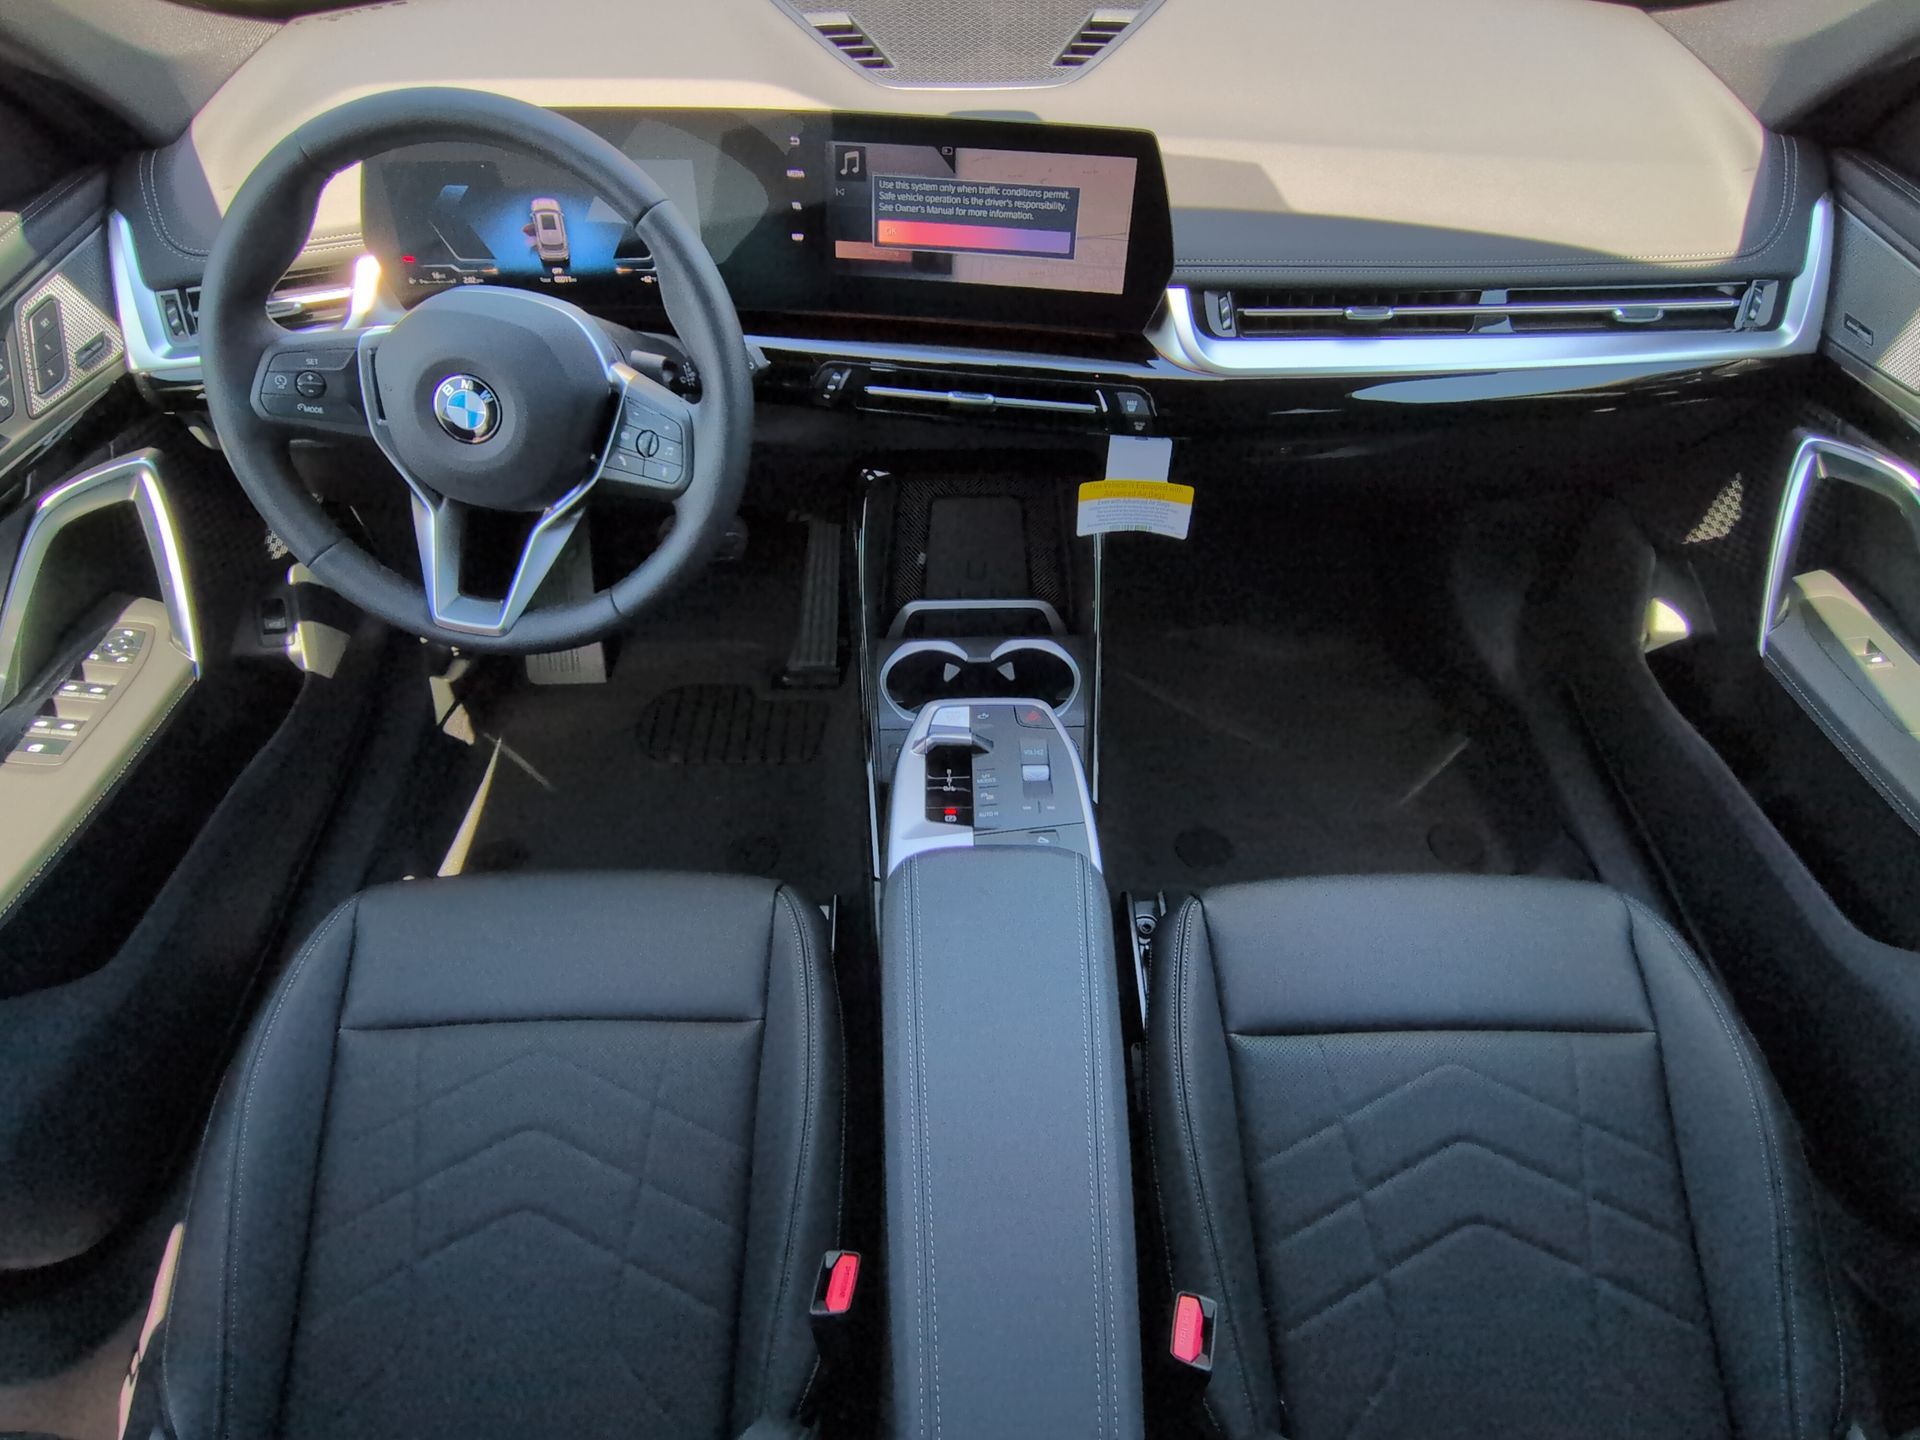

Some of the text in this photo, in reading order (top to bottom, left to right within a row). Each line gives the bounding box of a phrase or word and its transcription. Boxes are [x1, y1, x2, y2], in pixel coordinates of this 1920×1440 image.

[878, 180, 1071, 200] Use this system only when traffic conditions permit.
[878, 191, 1067, 212] Safe vehicle operation is the driver's responsibility.
[878, 202, 1034, 220] See Owner's Manual for more information.
[305, 358, 319, 366] SET
[442, 379, 494, 404] BMW
[304, 404, 324, 414] MODE
